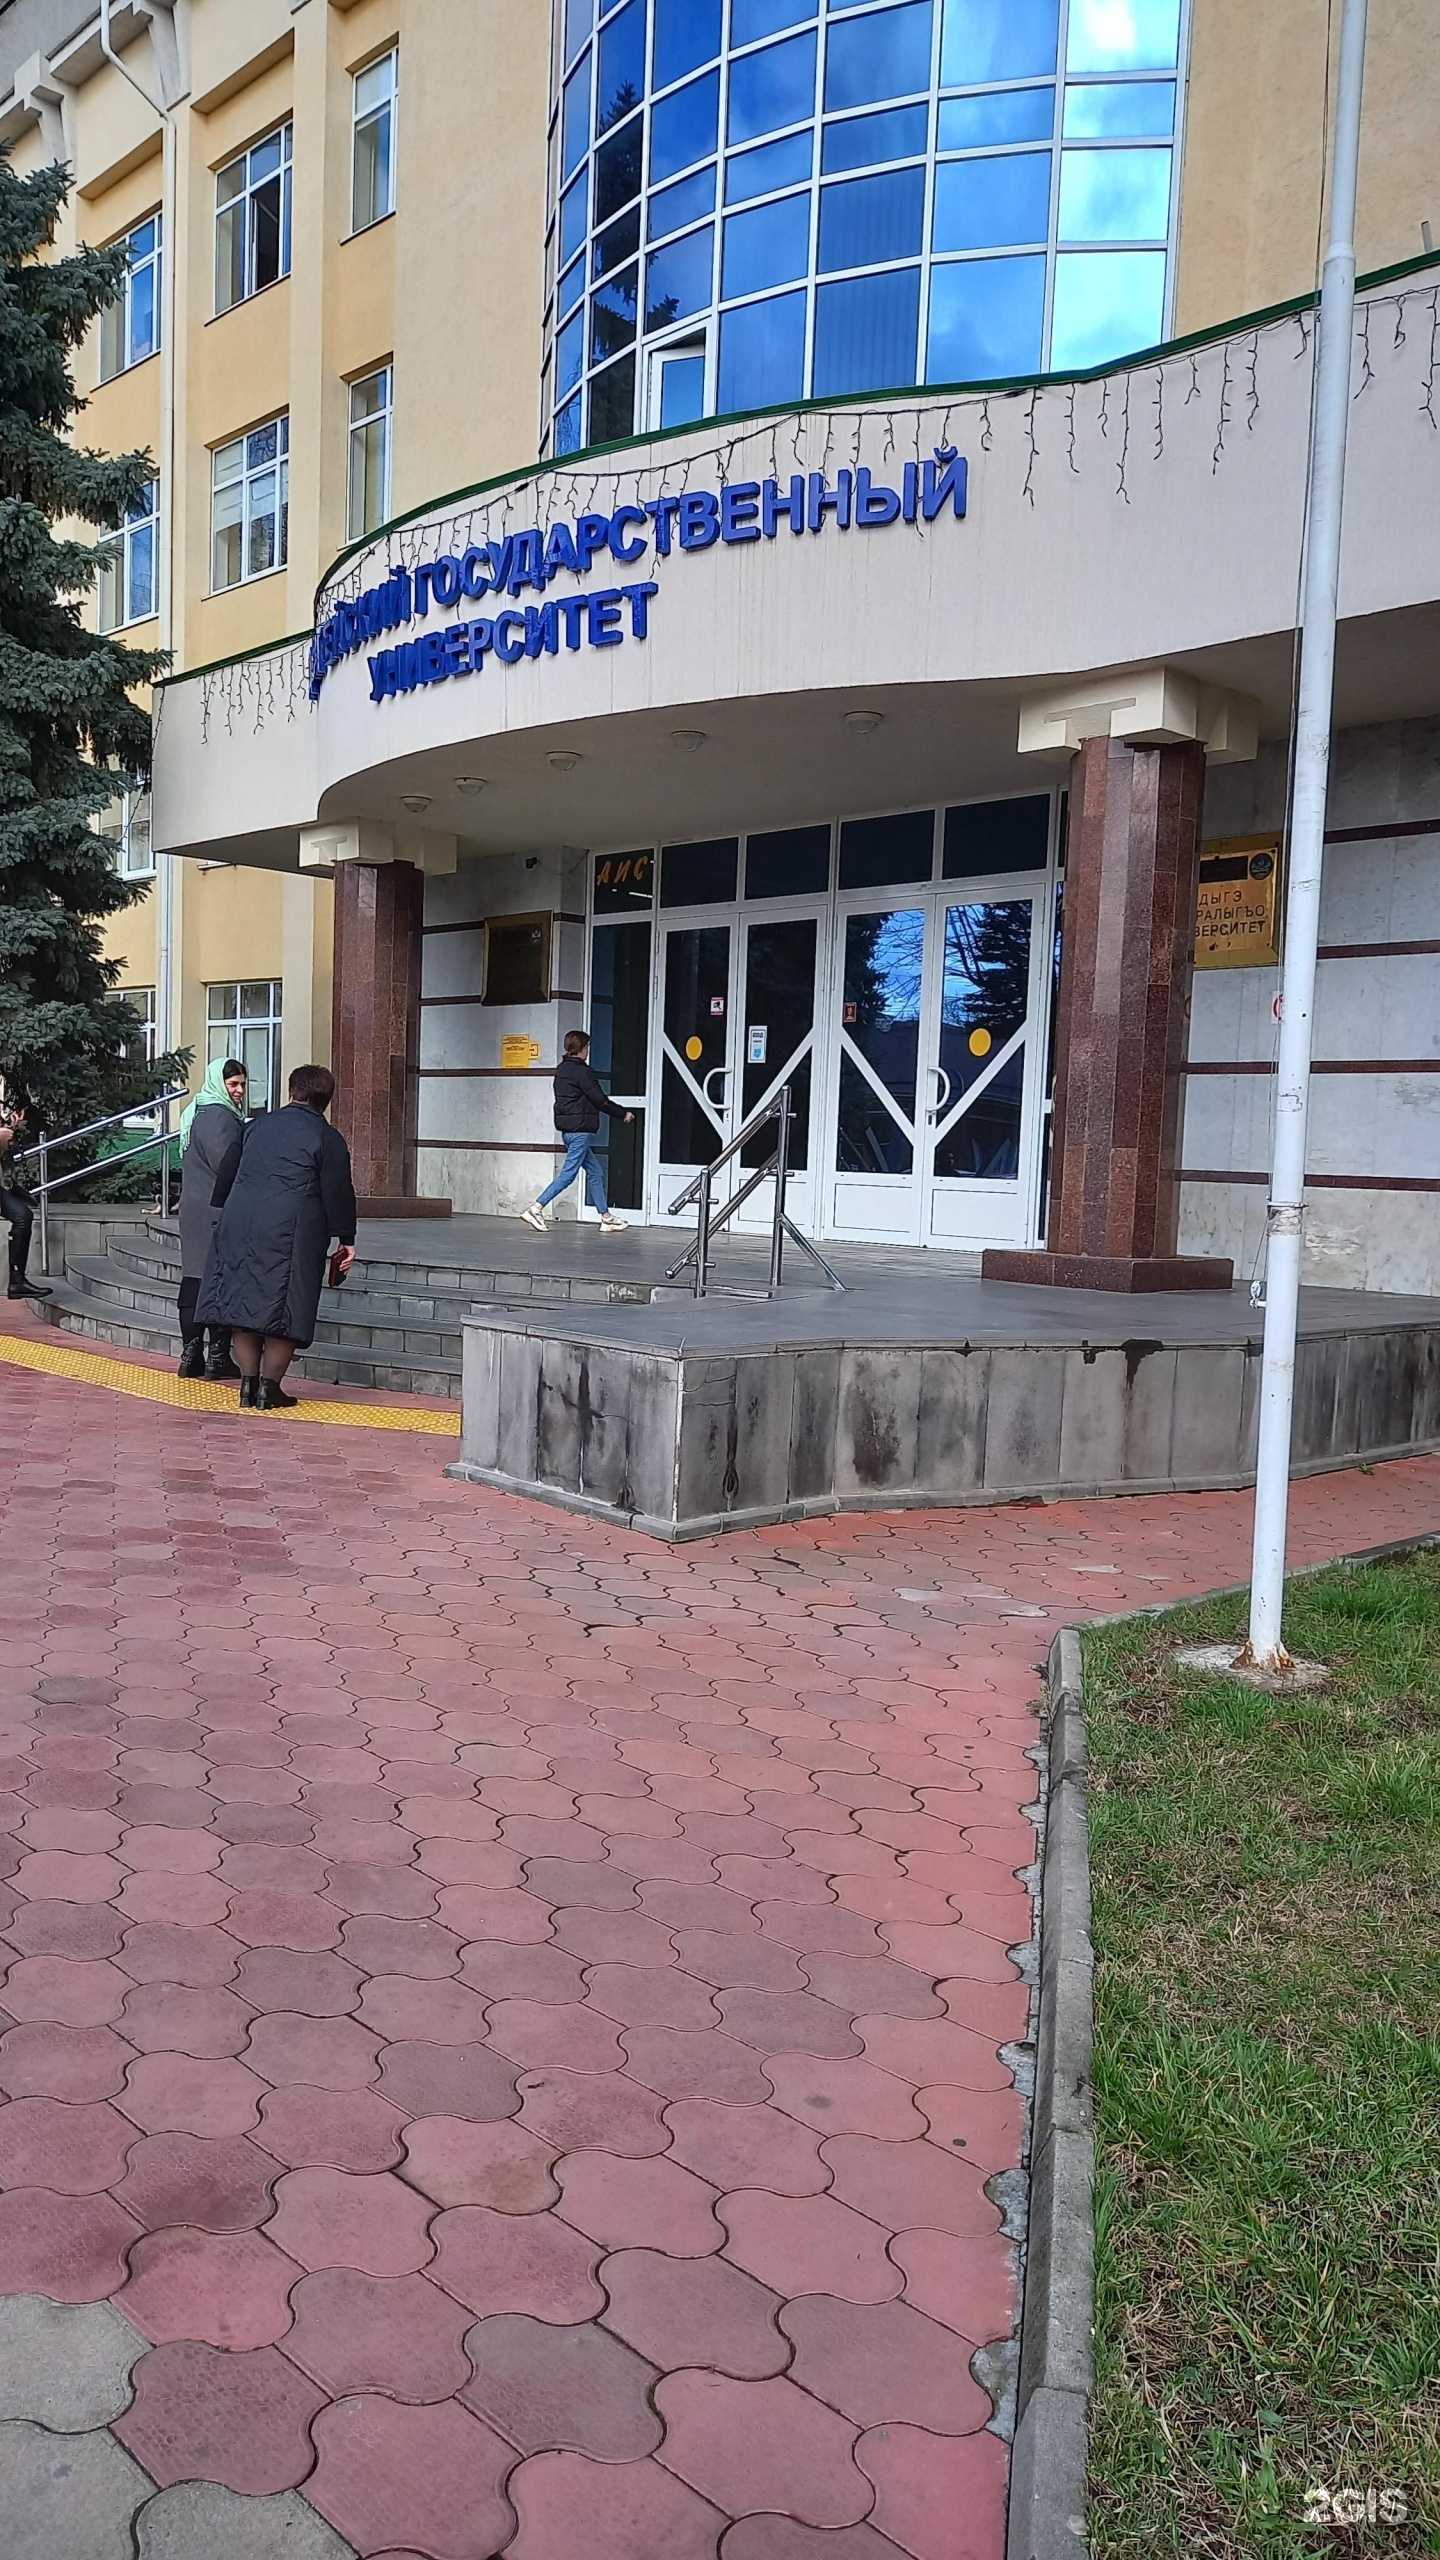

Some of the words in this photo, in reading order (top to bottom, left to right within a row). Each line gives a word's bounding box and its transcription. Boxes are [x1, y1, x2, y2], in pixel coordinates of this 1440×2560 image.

[415, 446, 969, 617] ГОСУДАРСТВЕННЫЙ
[367, 581, 659, 704] УНИВЕРСИТЕТ
[1199, 890, 1242, 906] ДЫГЭ
[1196, 904, 1265, 921] РАЛЫГЪО
[1195, 921, 1266, 937] ВЕРСИТЕТ
